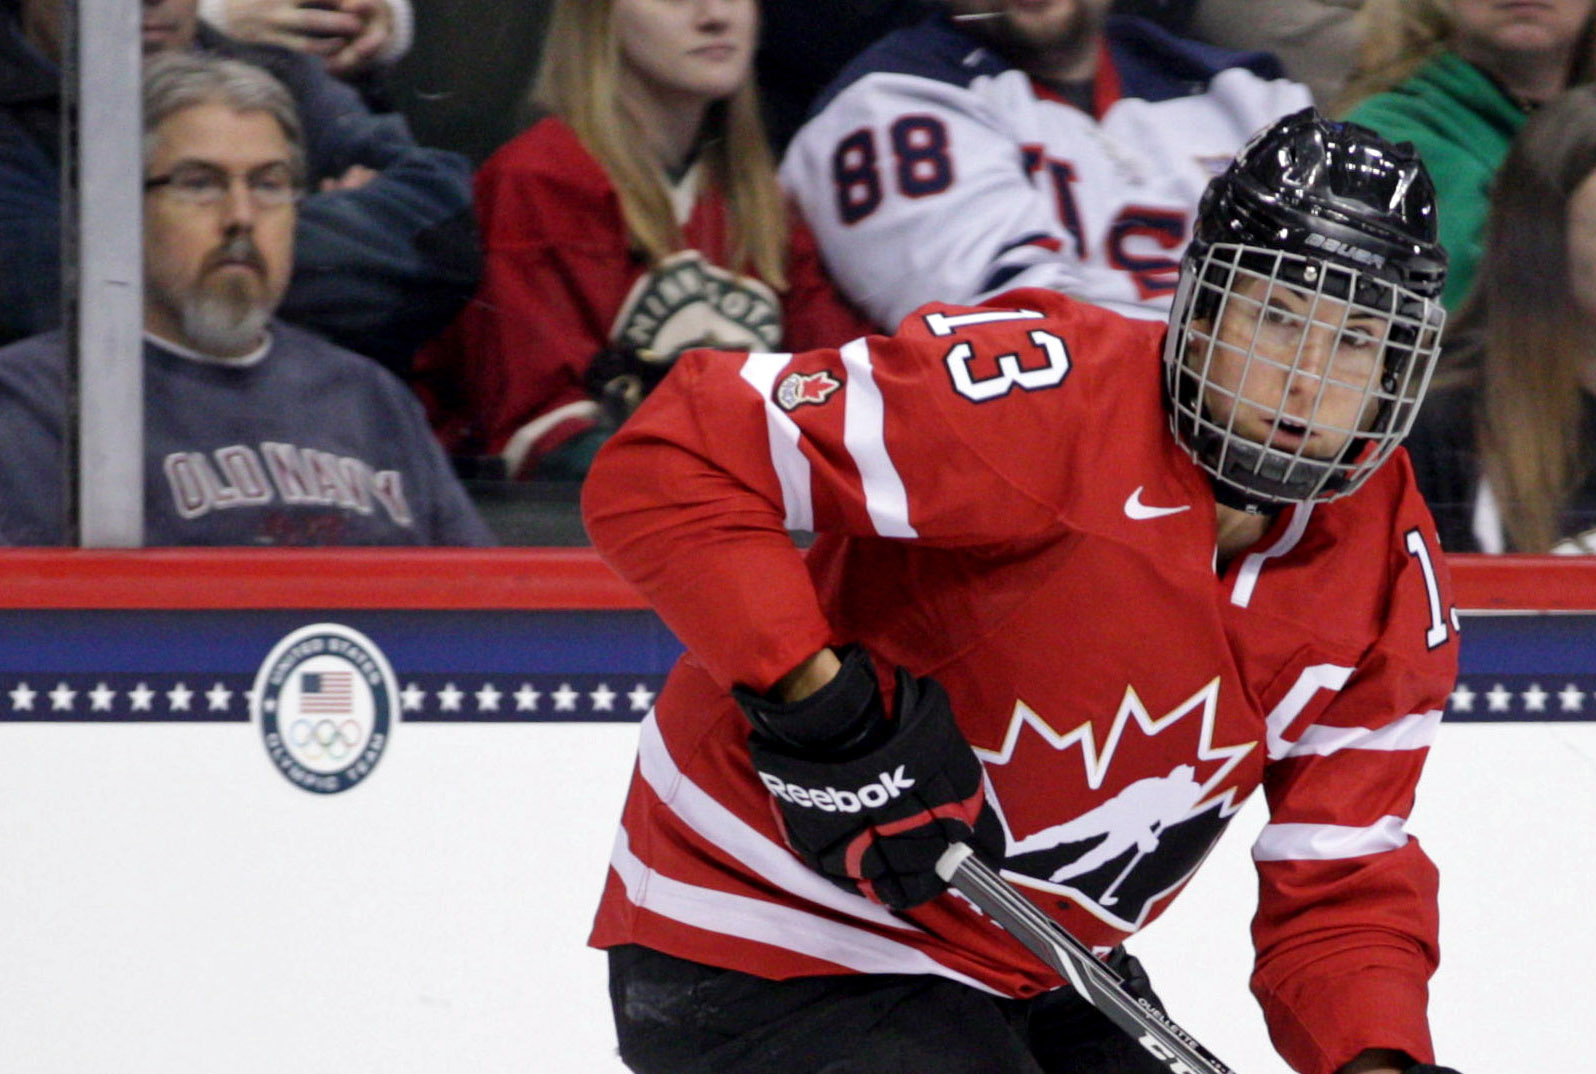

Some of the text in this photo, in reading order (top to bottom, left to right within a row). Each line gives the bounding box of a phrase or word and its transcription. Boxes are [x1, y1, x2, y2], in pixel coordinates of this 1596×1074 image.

[832, 113, 954, 226] 88
[1304, 232, 1386, 270] BAUER
[922, 308, 1073, 404] 13
[163, 441, 413, 525] OLD NAVY
[1404, 525, 1461, 653] 1
[757, 764, 916, 814] Reebok
[1136, 996, 1200, 1050] OUELLETTE
